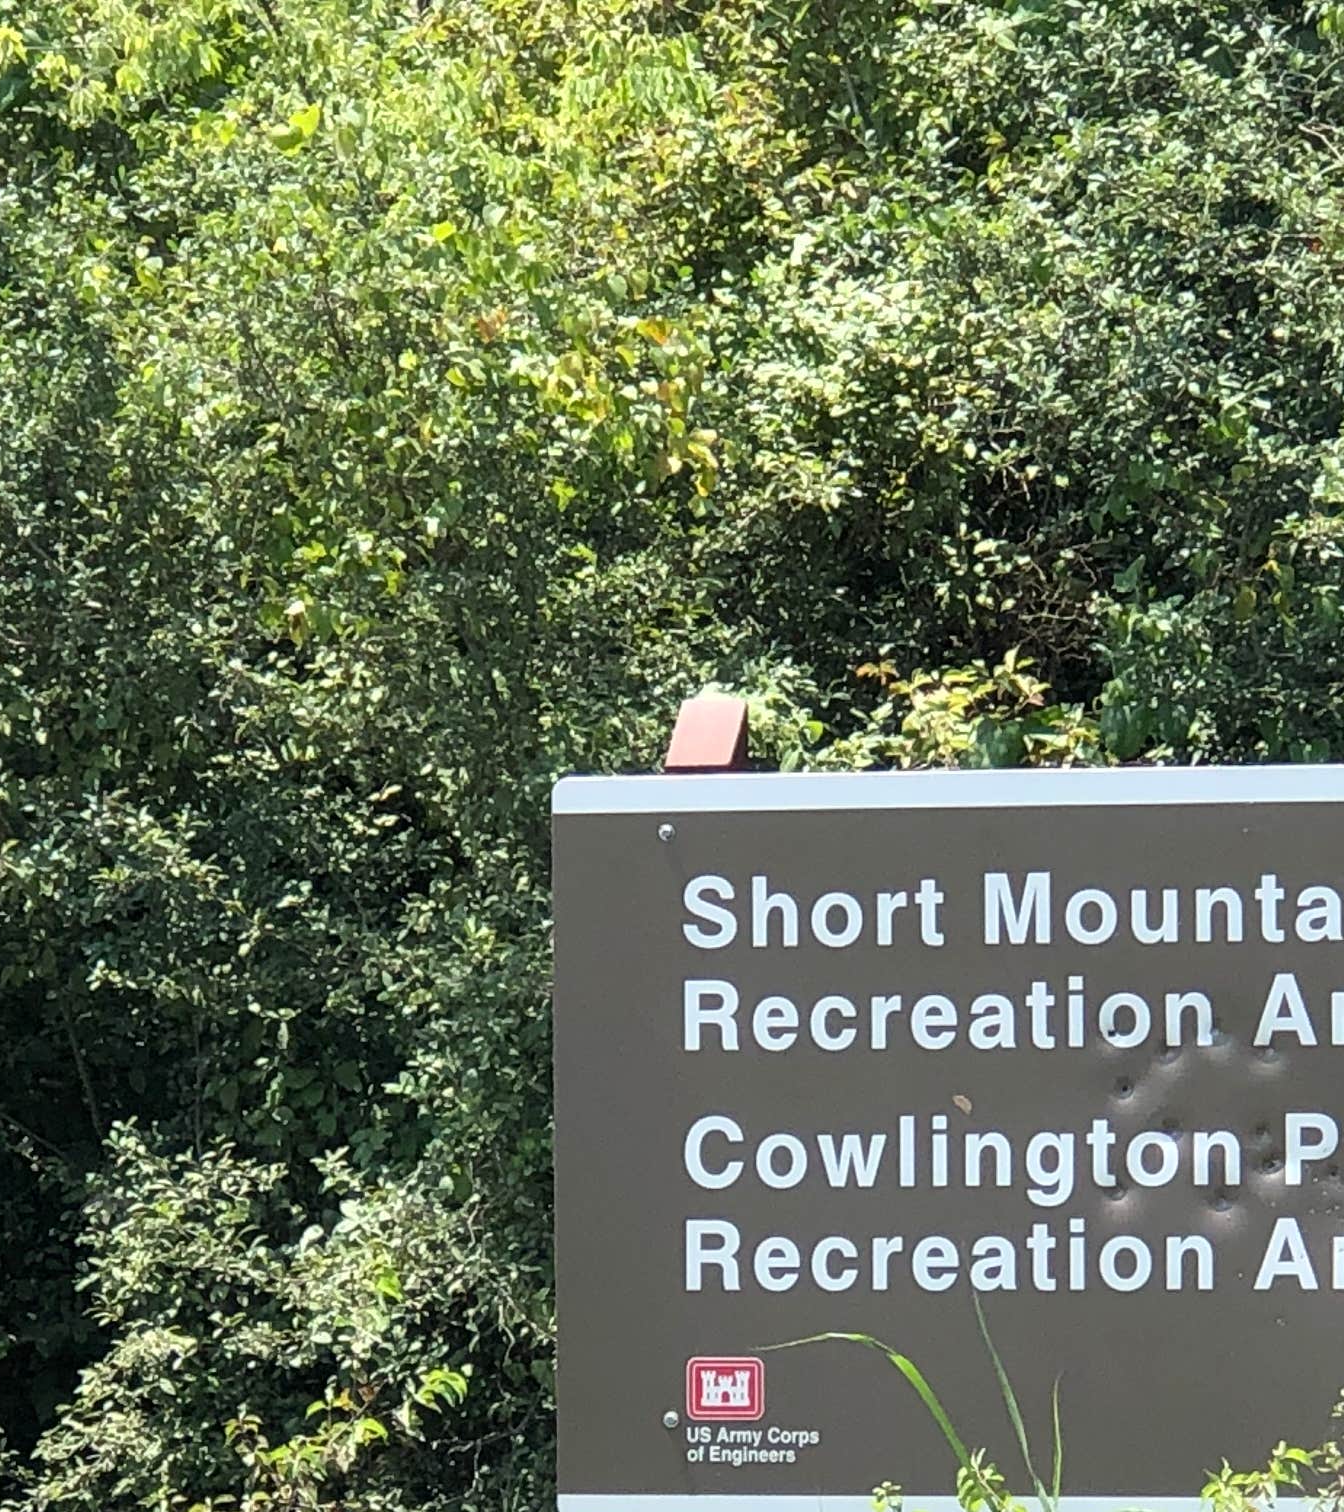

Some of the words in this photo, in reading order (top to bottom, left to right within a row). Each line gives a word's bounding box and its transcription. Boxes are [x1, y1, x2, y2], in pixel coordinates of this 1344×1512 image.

[682, 874, 946, 950] Short
[683, 974, 1214, 1053] Recreation
[684, 1114, 1241, 1209] Cowlington
[684, 1212, 1215, 1292] Recreation
[686, 1427, 711, 1443] US
[716, 1427, 763, 1448] Army
[767, 1427, 820, 1448] Corps
[686, 1446, 705, 1463] of
[709, 1446, 797, 1467] Engineers
